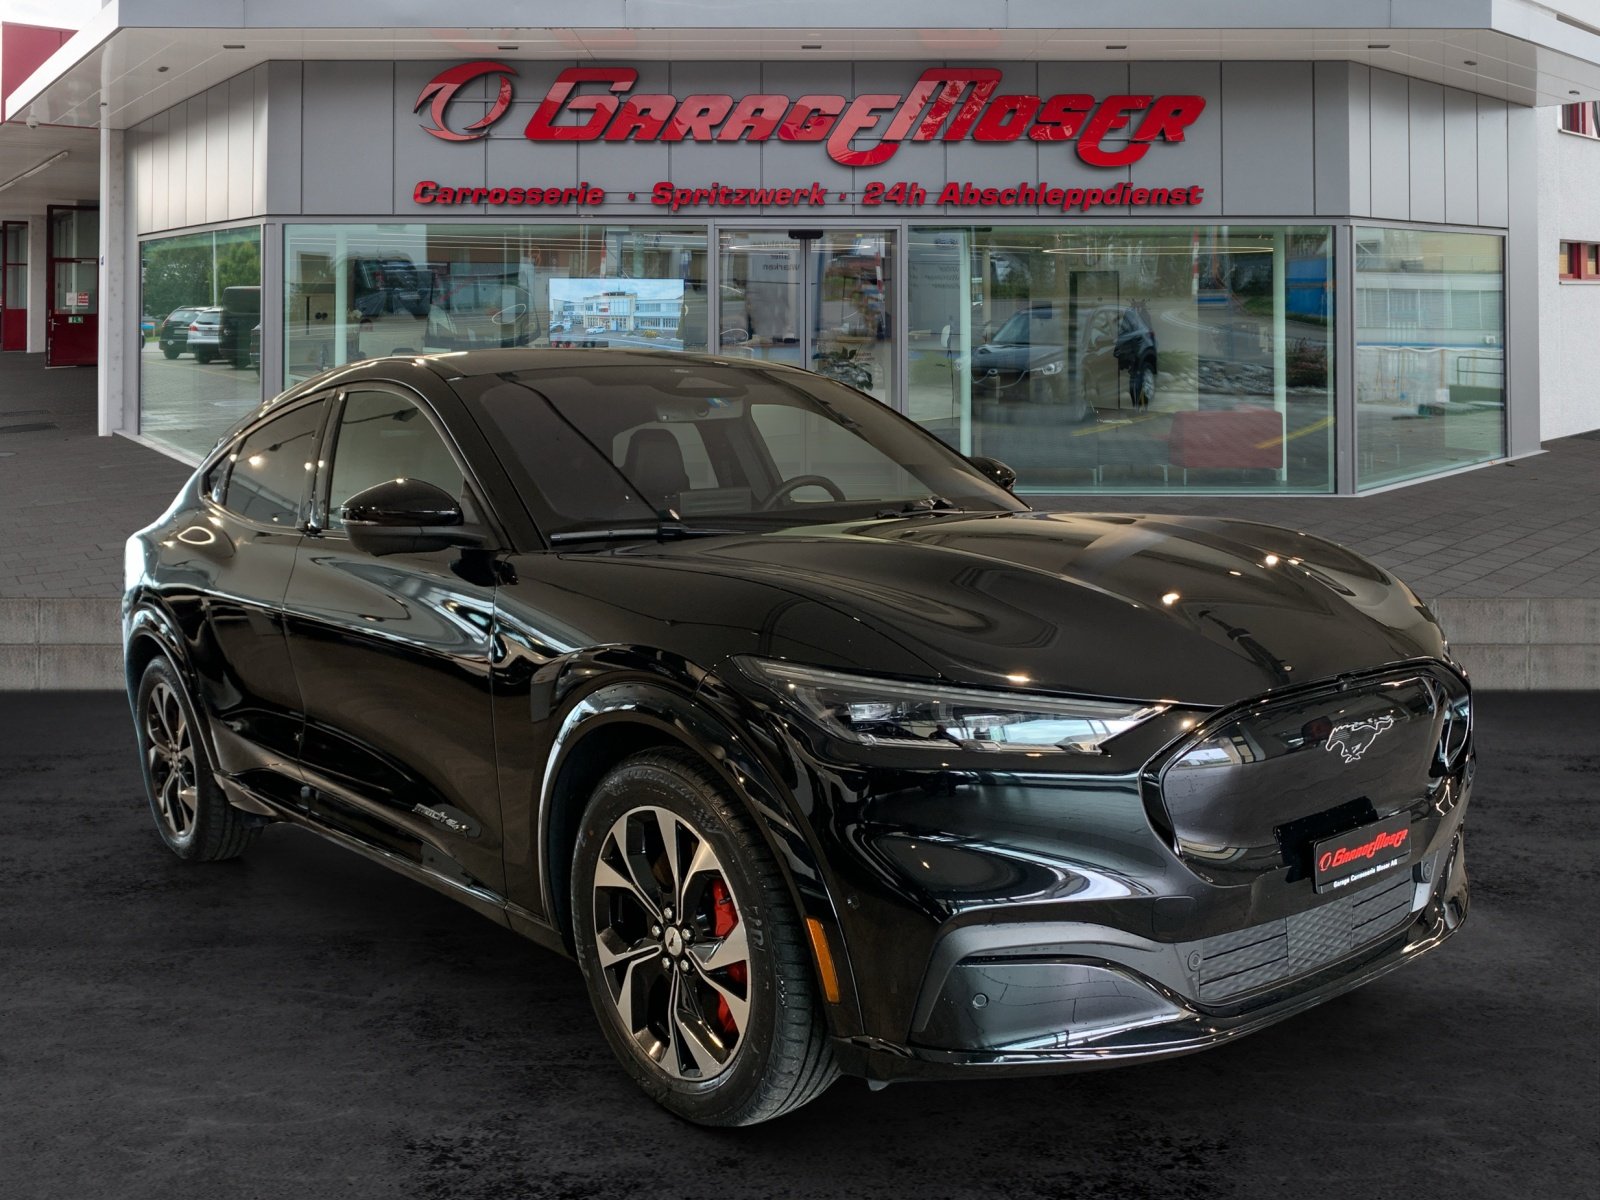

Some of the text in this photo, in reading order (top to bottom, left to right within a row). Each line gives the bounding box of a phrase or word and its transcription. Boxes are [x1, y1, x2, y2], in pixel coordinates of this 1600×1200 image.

[413, 180, 1204, 211] Carrosserie Spritzwerk 24h Abschleppdienst
